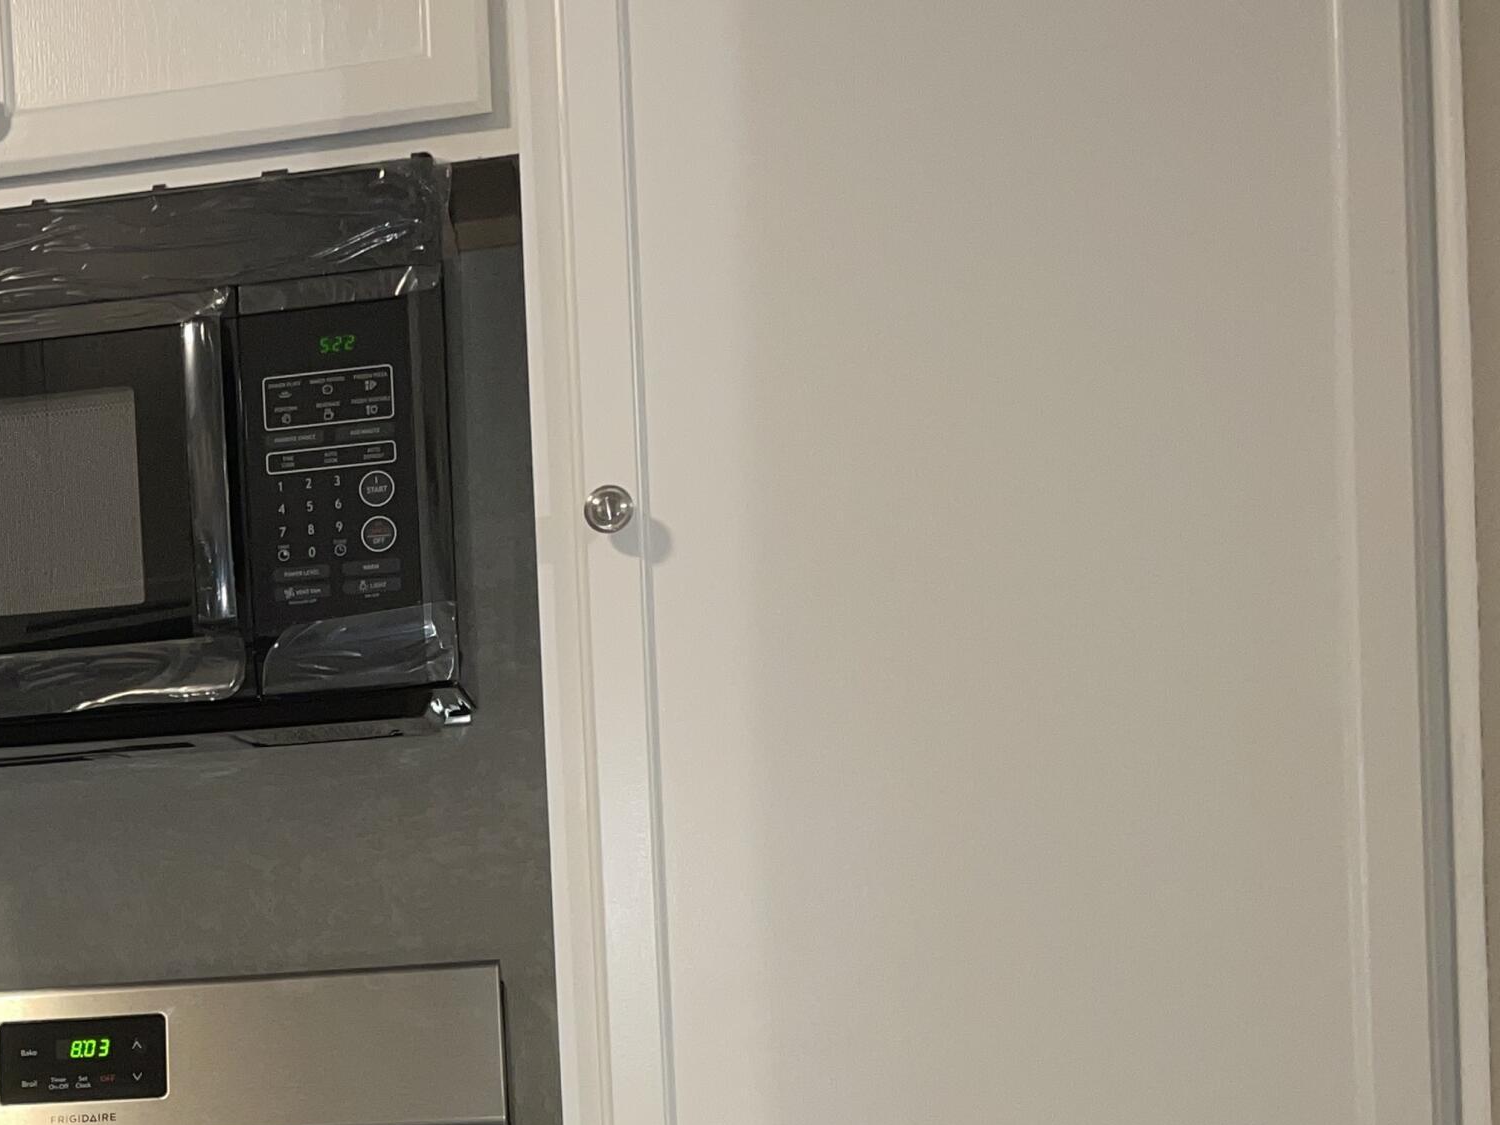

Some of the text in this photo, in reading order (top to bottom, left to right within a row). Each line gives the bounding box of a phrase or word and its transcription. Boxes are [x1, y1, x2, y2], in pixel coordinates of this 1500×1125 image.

[277, 475, 341, 492] 1 2 3
[366, 485, 388, 494] START
[278, 499, 342, 514] 4 5 6
[278, 521, 343, 538] 7 8 9
[308, 546, 316, 558] 0
[20, 1049, 38, 1057] Bake
[21, 1080, 38, 1088] Broil
[50, 1112, 117, 1124] FRIGIDAIRE
